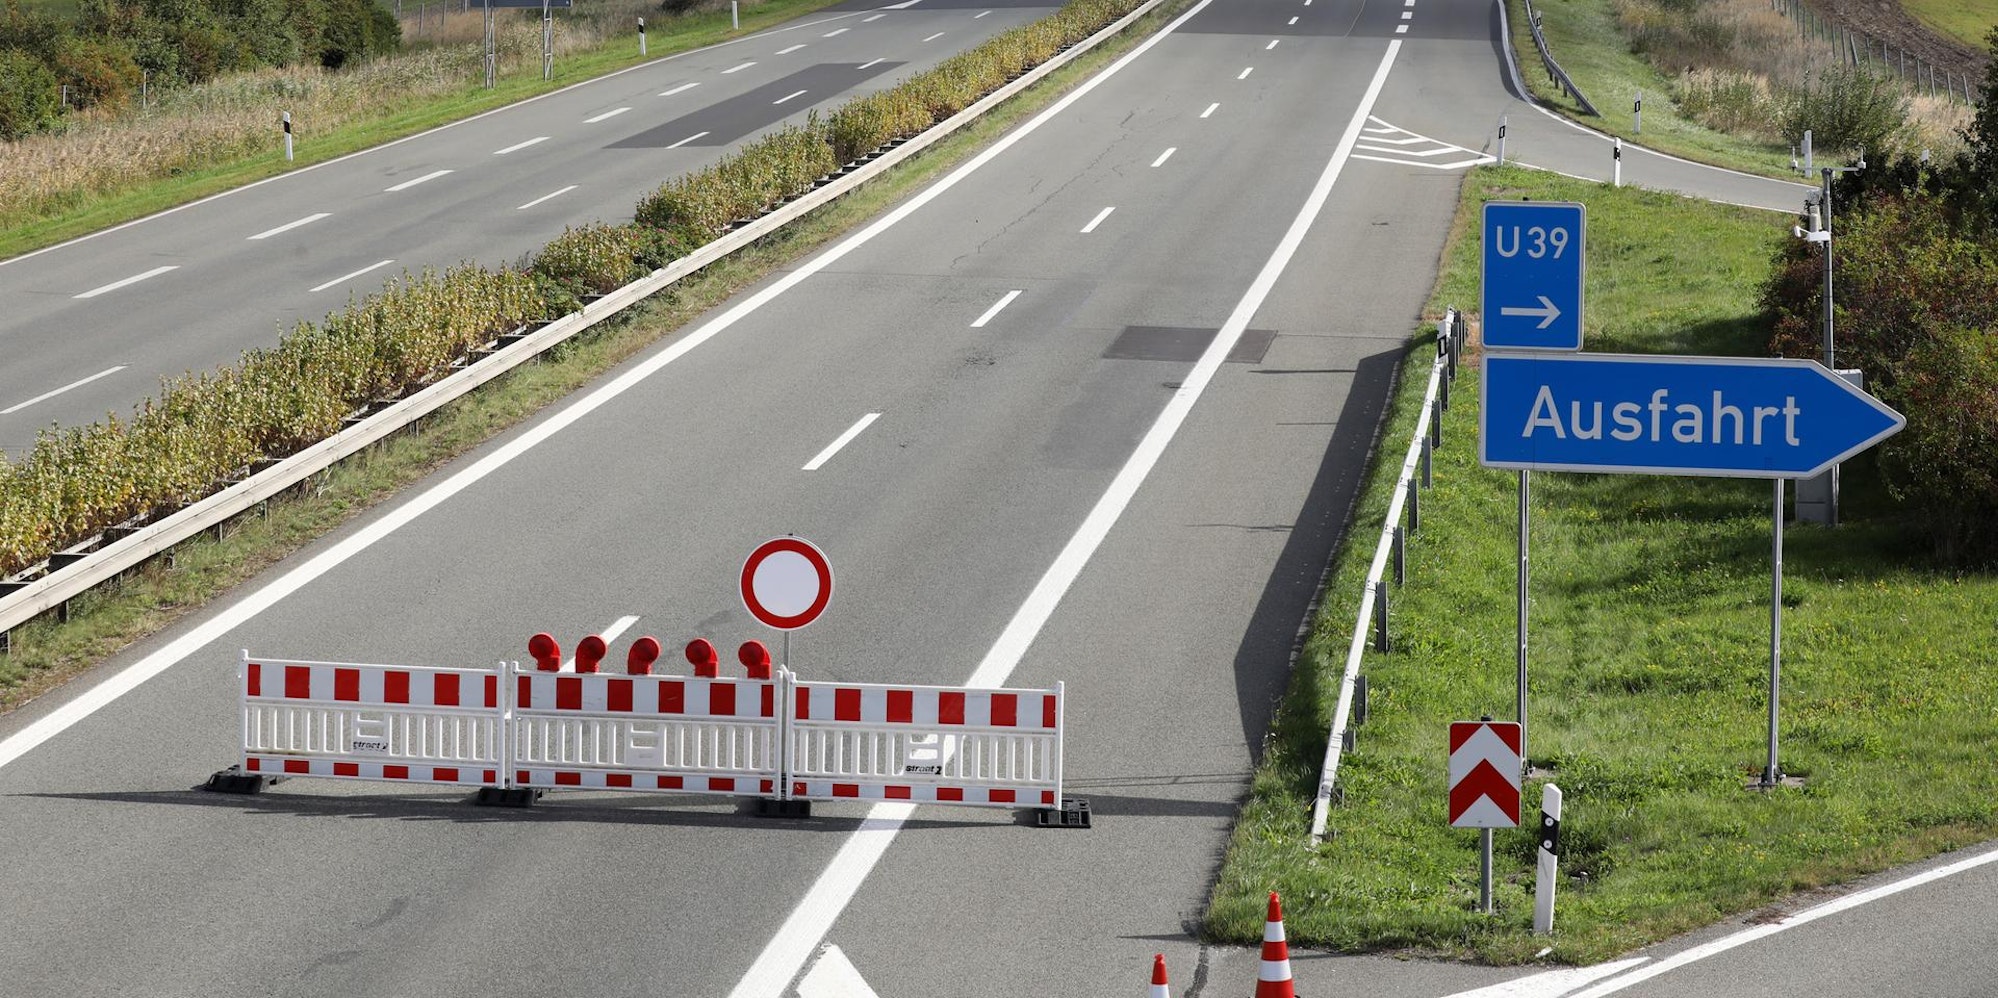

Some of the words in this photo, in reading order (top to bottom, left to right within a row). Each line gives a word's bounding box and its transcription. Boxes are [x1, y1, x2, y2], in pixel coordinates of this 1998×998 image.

[1496, 225, 1519, 258] U
[1527, 226, 1569, 259] 39
[1521, 385, 1801, 447] Ausfahrt
